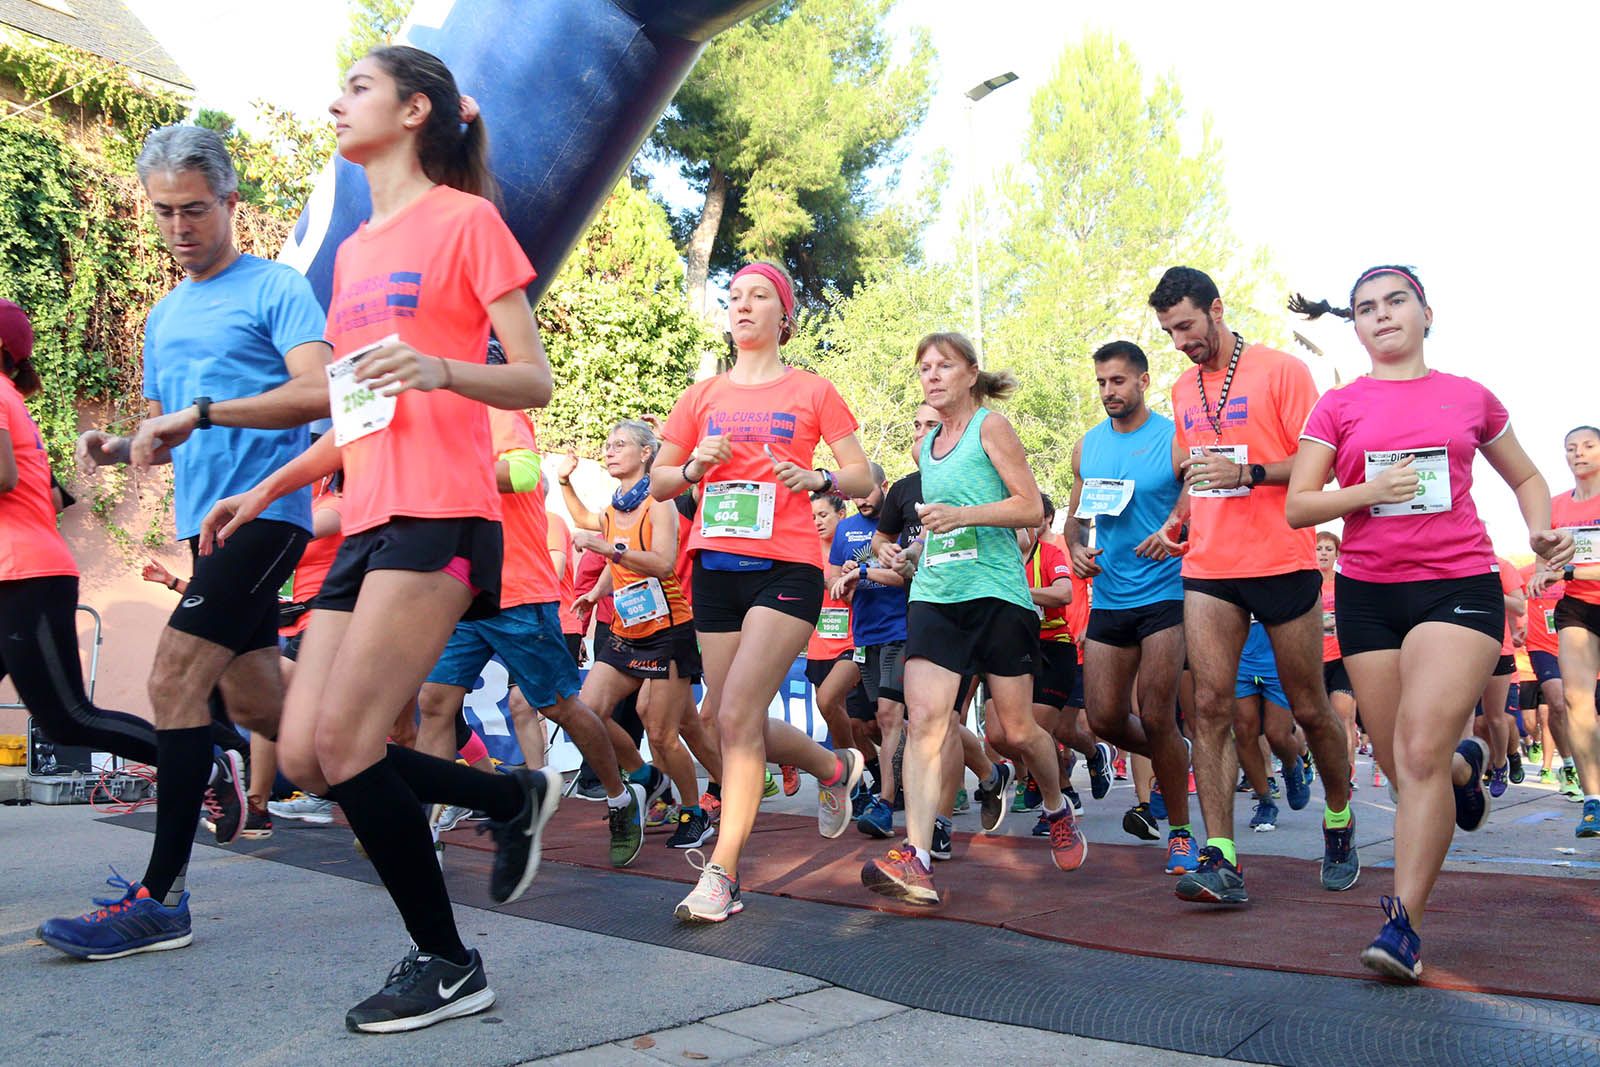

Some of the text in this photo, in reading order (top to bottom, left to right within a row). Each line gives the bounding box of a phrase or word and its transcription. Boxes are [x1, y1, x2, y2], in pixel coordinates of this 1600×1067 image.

[733, 410, 770, 423] CURSA
[1415, 470, 1437, 481] NA
[1415, 484, 1426, 496] 9
[713, 511, 740, 522] 604
[942, 538, 955, 550] 79
